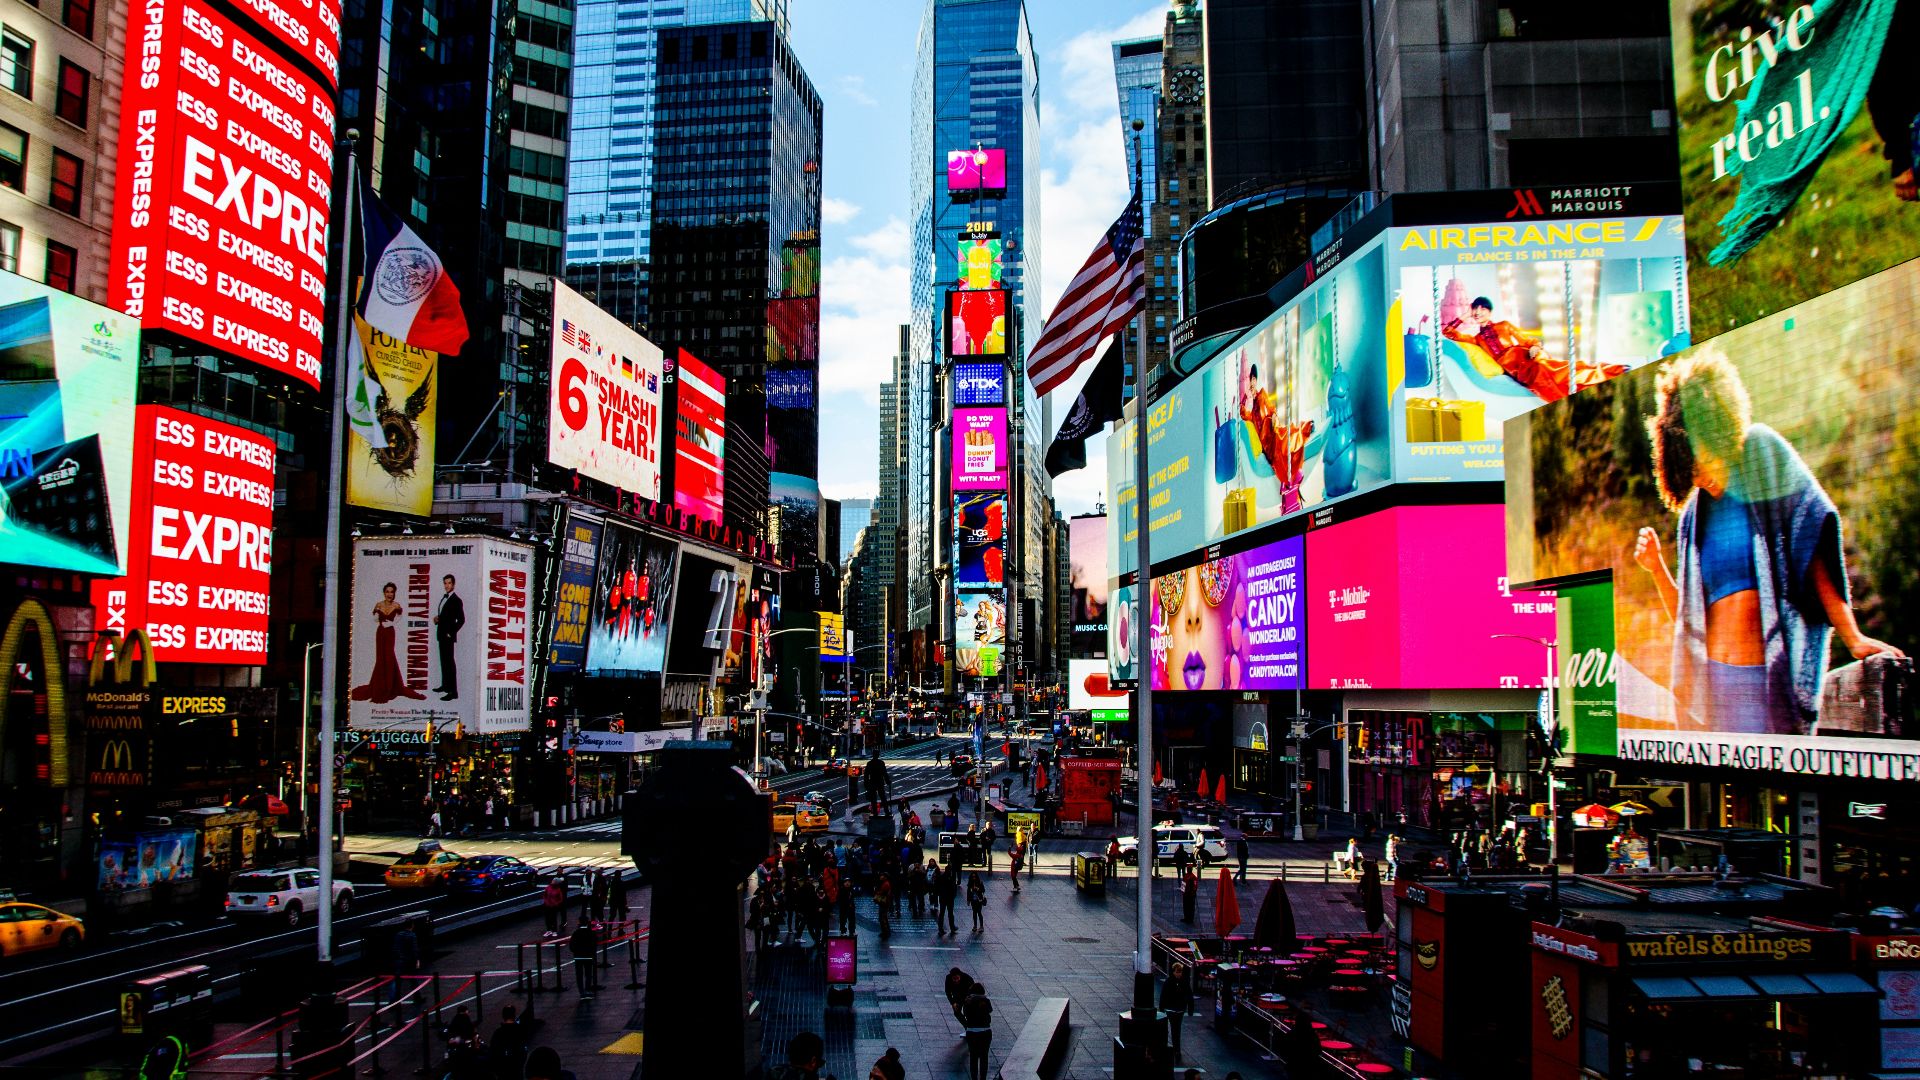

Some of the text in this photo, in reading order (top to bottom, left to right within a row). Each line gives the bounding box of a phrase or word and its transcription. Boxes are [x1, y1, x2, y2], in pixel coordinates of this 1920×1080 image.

[182, 5, 307, 105] ESS EXPRESS
[1704, 4, 1816, 102] Give
[179, 46, 303, 140] ESS EXPRESS
[176, 89, 302, 181] ESS EXPRESS
[1710, 68, 1831, 182] real.
[130, 109, 157, 228] EXPRESS
[183, 135, 331, 275] EXPRE
[1550, 186, 1633, 200] MARRIOTT
[1551, 200, 1624, 213] MARQUIS
[966, 221, 994, 233] 2018
[1400, 220, 1626, 251] AIRFRANCE
[168, 205, 294, 282] ESS EXPRESS
[1316, 237, 1344, 265] MARRIOTT
[1457, 247, 1606, 264] FRANCE IS IN THE AIR
[1316, 252, 1341, 276] MARQUIS
[124, 246, 148, 320] EXPR
[165, 249, 293, 322] ESS EXPRESS
[162, 297, 290, 363] ESS EXPRESS
[1172, 316, 1198, 338] MARRIOTT
[376, 350, 423, 371] CURSED CHILD
[969, 378, 1000, 390] TDK
[598, 376, 649, 427] SMASH
[155, 416, 272, 471] ESS EXPRESS
[1411, 444, 1496, 456] PUTTING YOU
[153, 458, 270, 508] ESS EXPRESS
[1156, 467, 1167, 486] THE
[1167, 455, 1190, 479] CENTER
[1151, 487, 1171, 511] WORLD
[1315, 507, 1334, 519] MARRIOTT
[616, 486, 777, 564] 1540 BROADWAY
[972, 529, 989, 538] UGG
[1315, 515, 1332, 527] MARQUIS
[1247, 555, 1296, 578] AN OUTRAGEOUSLY
[147, 579, 266, 615] ESS EXPRESS
[408, 563, 431, 621] PRETTY
[560, 582, 592, 606] COME
[1248, 573, 1297, 598] INTERACTIVE
[1248, 592, 1297, 628] CANDY
[1512, 603, 1534, 614] THE
[195, 625, 264, 653] EXPRESS
[487, 569, 509, 681] WOMAN
[505, 569, 527, 685] PRETTY
[553, 622, 587, 645] AWAY
[1248, 627, 1297, 646] WONDERLAND
[406, 629, 429, 691] WOMAN
[1249, 654, 1260, 662] Tickets
[1249, 664, 1298, 679] CANDYTOPIA.COM
[87, 692, 150, 703] McDonald's
[162, 696, 226, 714] EXPRESS
[486, 687, 524, 711] THE MUSICAL
[577, 734, 604, 749] Disney
[1619, 738, 1920, 784] AMERICAN EAGLE OUTFITTE
